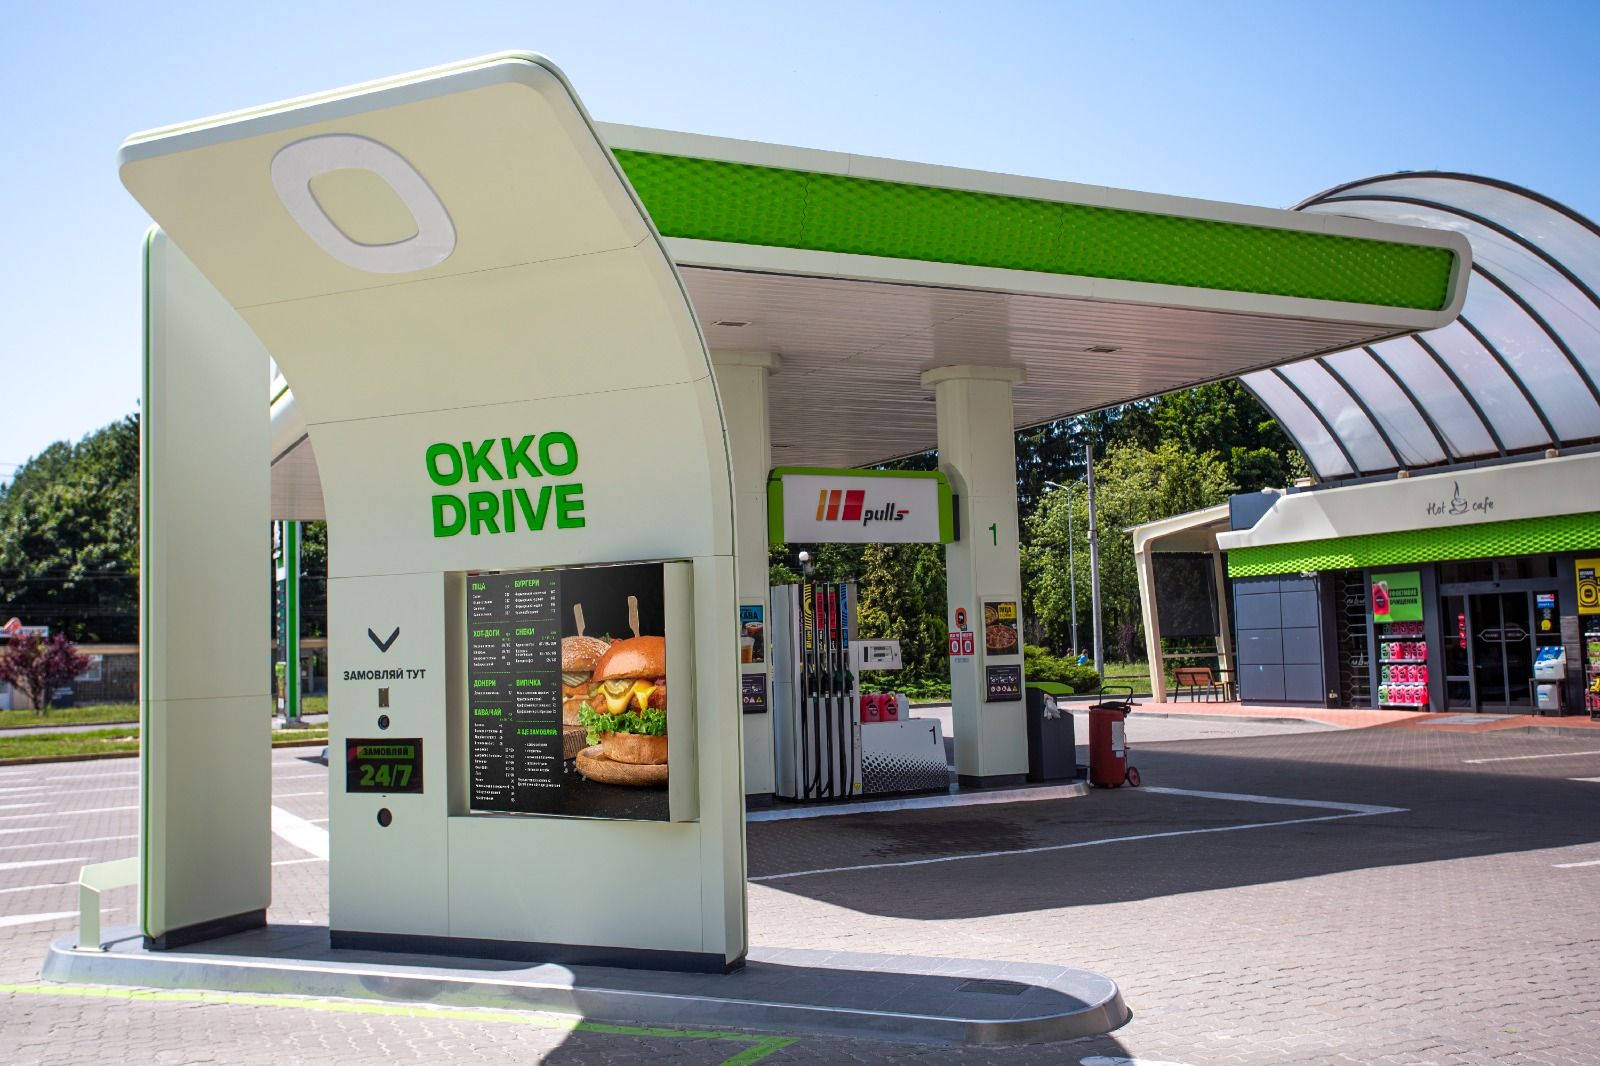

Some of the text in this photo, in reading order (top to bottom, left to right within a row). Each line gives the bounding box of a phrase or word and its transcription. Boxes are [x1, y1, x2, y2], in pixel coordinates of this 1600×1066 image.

[425, 431, 579, 486] OKKO
[431, 483, 586, 537] DRIVE
[863, 502, 910, 527] pulls
[1426, 496, 1494, 516] Hot cafe
[988, 522, 997, 546] 1
[514, 579, 540, 588] БУРГЕРИ
[473, 629, 500, 638] ХОТ-ДОГИ
[343, 667, 427, 681] ЗАМОВЛЯЙ ТУТ
[473, 679, 497, 687] ДОНЕРИ
[516, 678, 541, 687] ВИПІЧКА
[928, 725, 937, 745] 1
[362, 746, 409, 756] ЗАМОВЛЯЙ
[359, 763, 413, 787] 24/7
